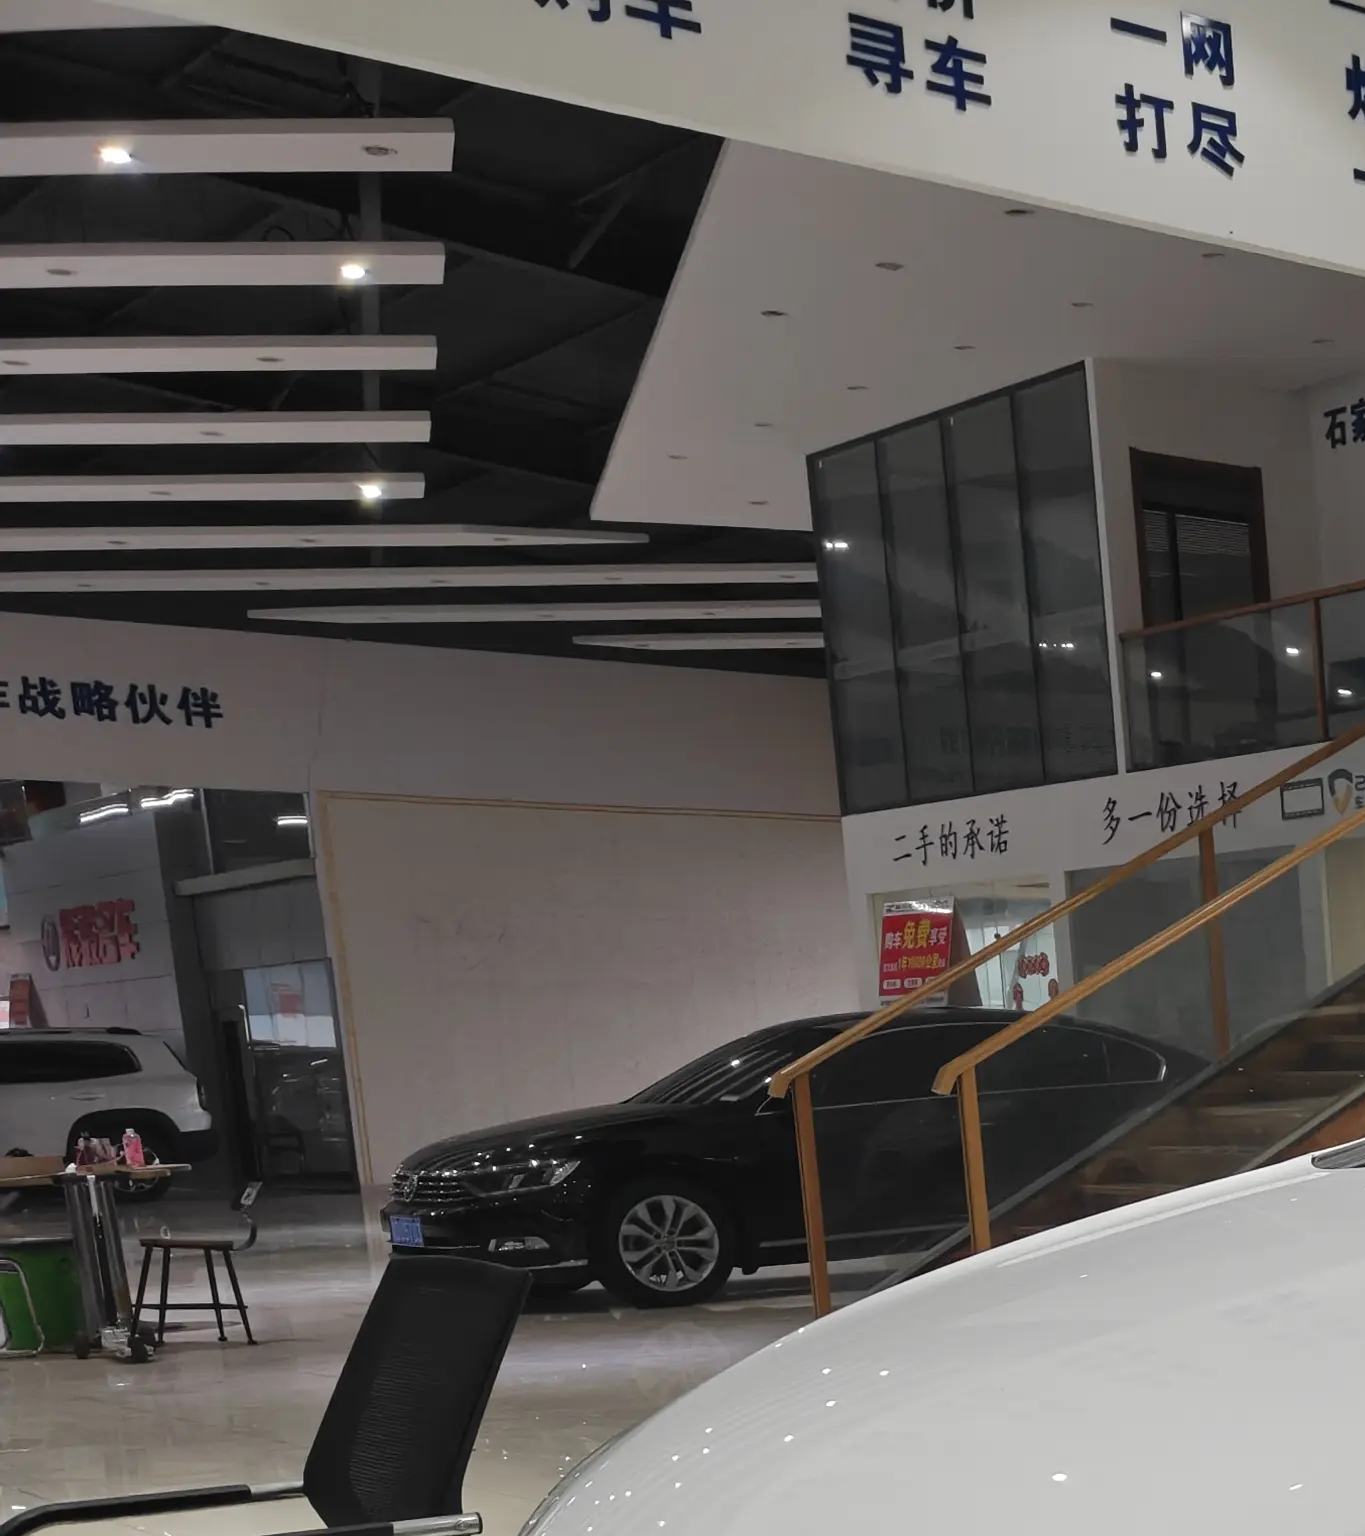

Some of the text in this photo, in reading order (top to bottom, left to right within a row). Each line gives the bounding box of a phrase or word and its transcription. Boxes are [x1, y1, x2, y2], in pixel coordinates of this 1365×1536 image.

[846, 12, 992, 111] 寻车
[1110, 10, 1235, 86] 一网
[1115, 83, 1246, 177] 打尽
[892, 814, 1011, 867] 二手的承诺
